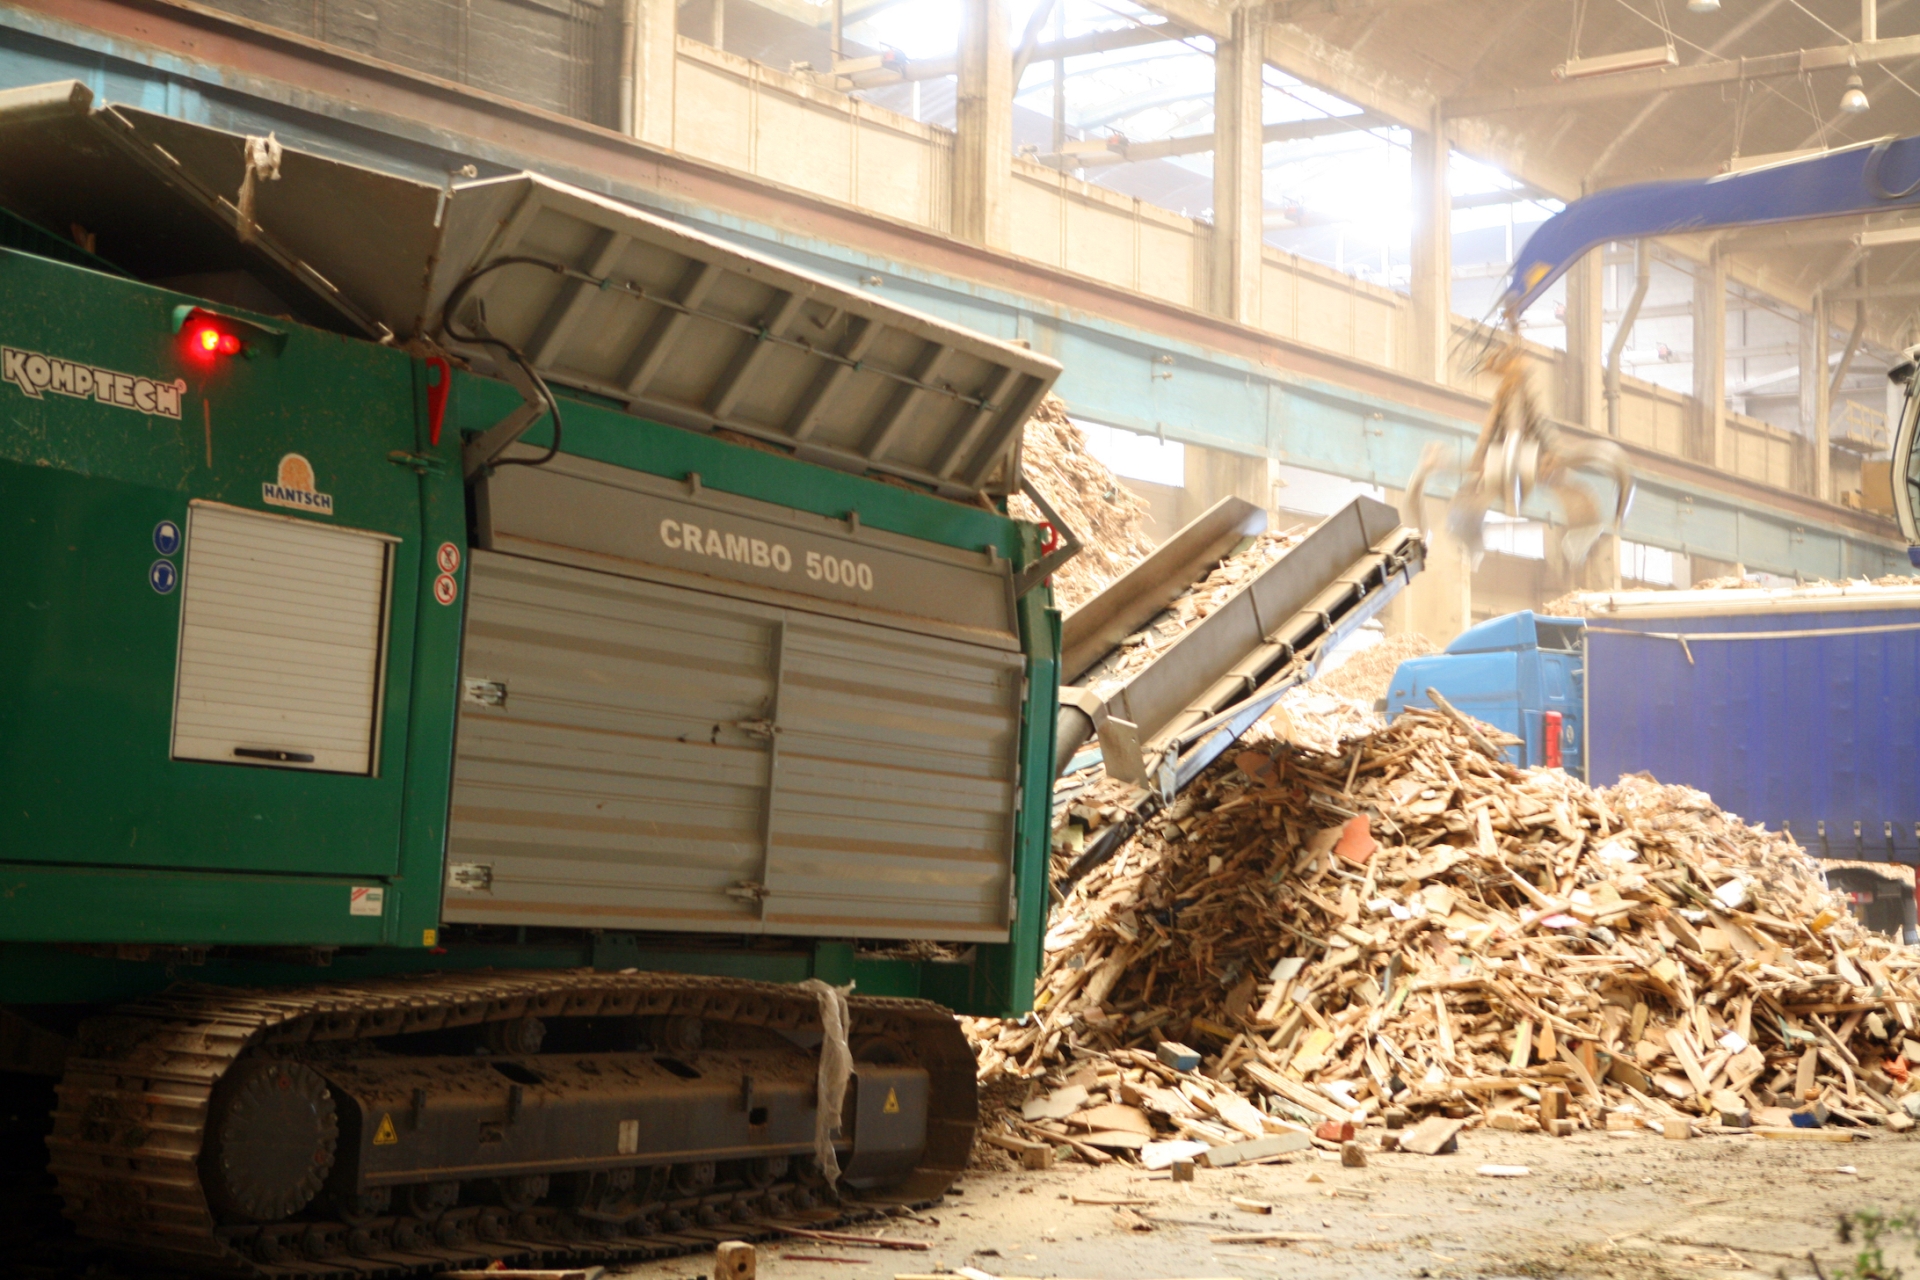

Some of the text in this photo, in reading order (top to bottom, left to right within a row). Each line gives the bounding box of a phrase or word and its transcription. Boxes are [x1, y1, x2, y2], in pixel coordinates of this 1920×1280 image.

[2, 347, 181, 418] KOMPTECH
[264, 484, 331, 509] HANTSCH
[659, 518, 874, 591] CRAMBO 5000
